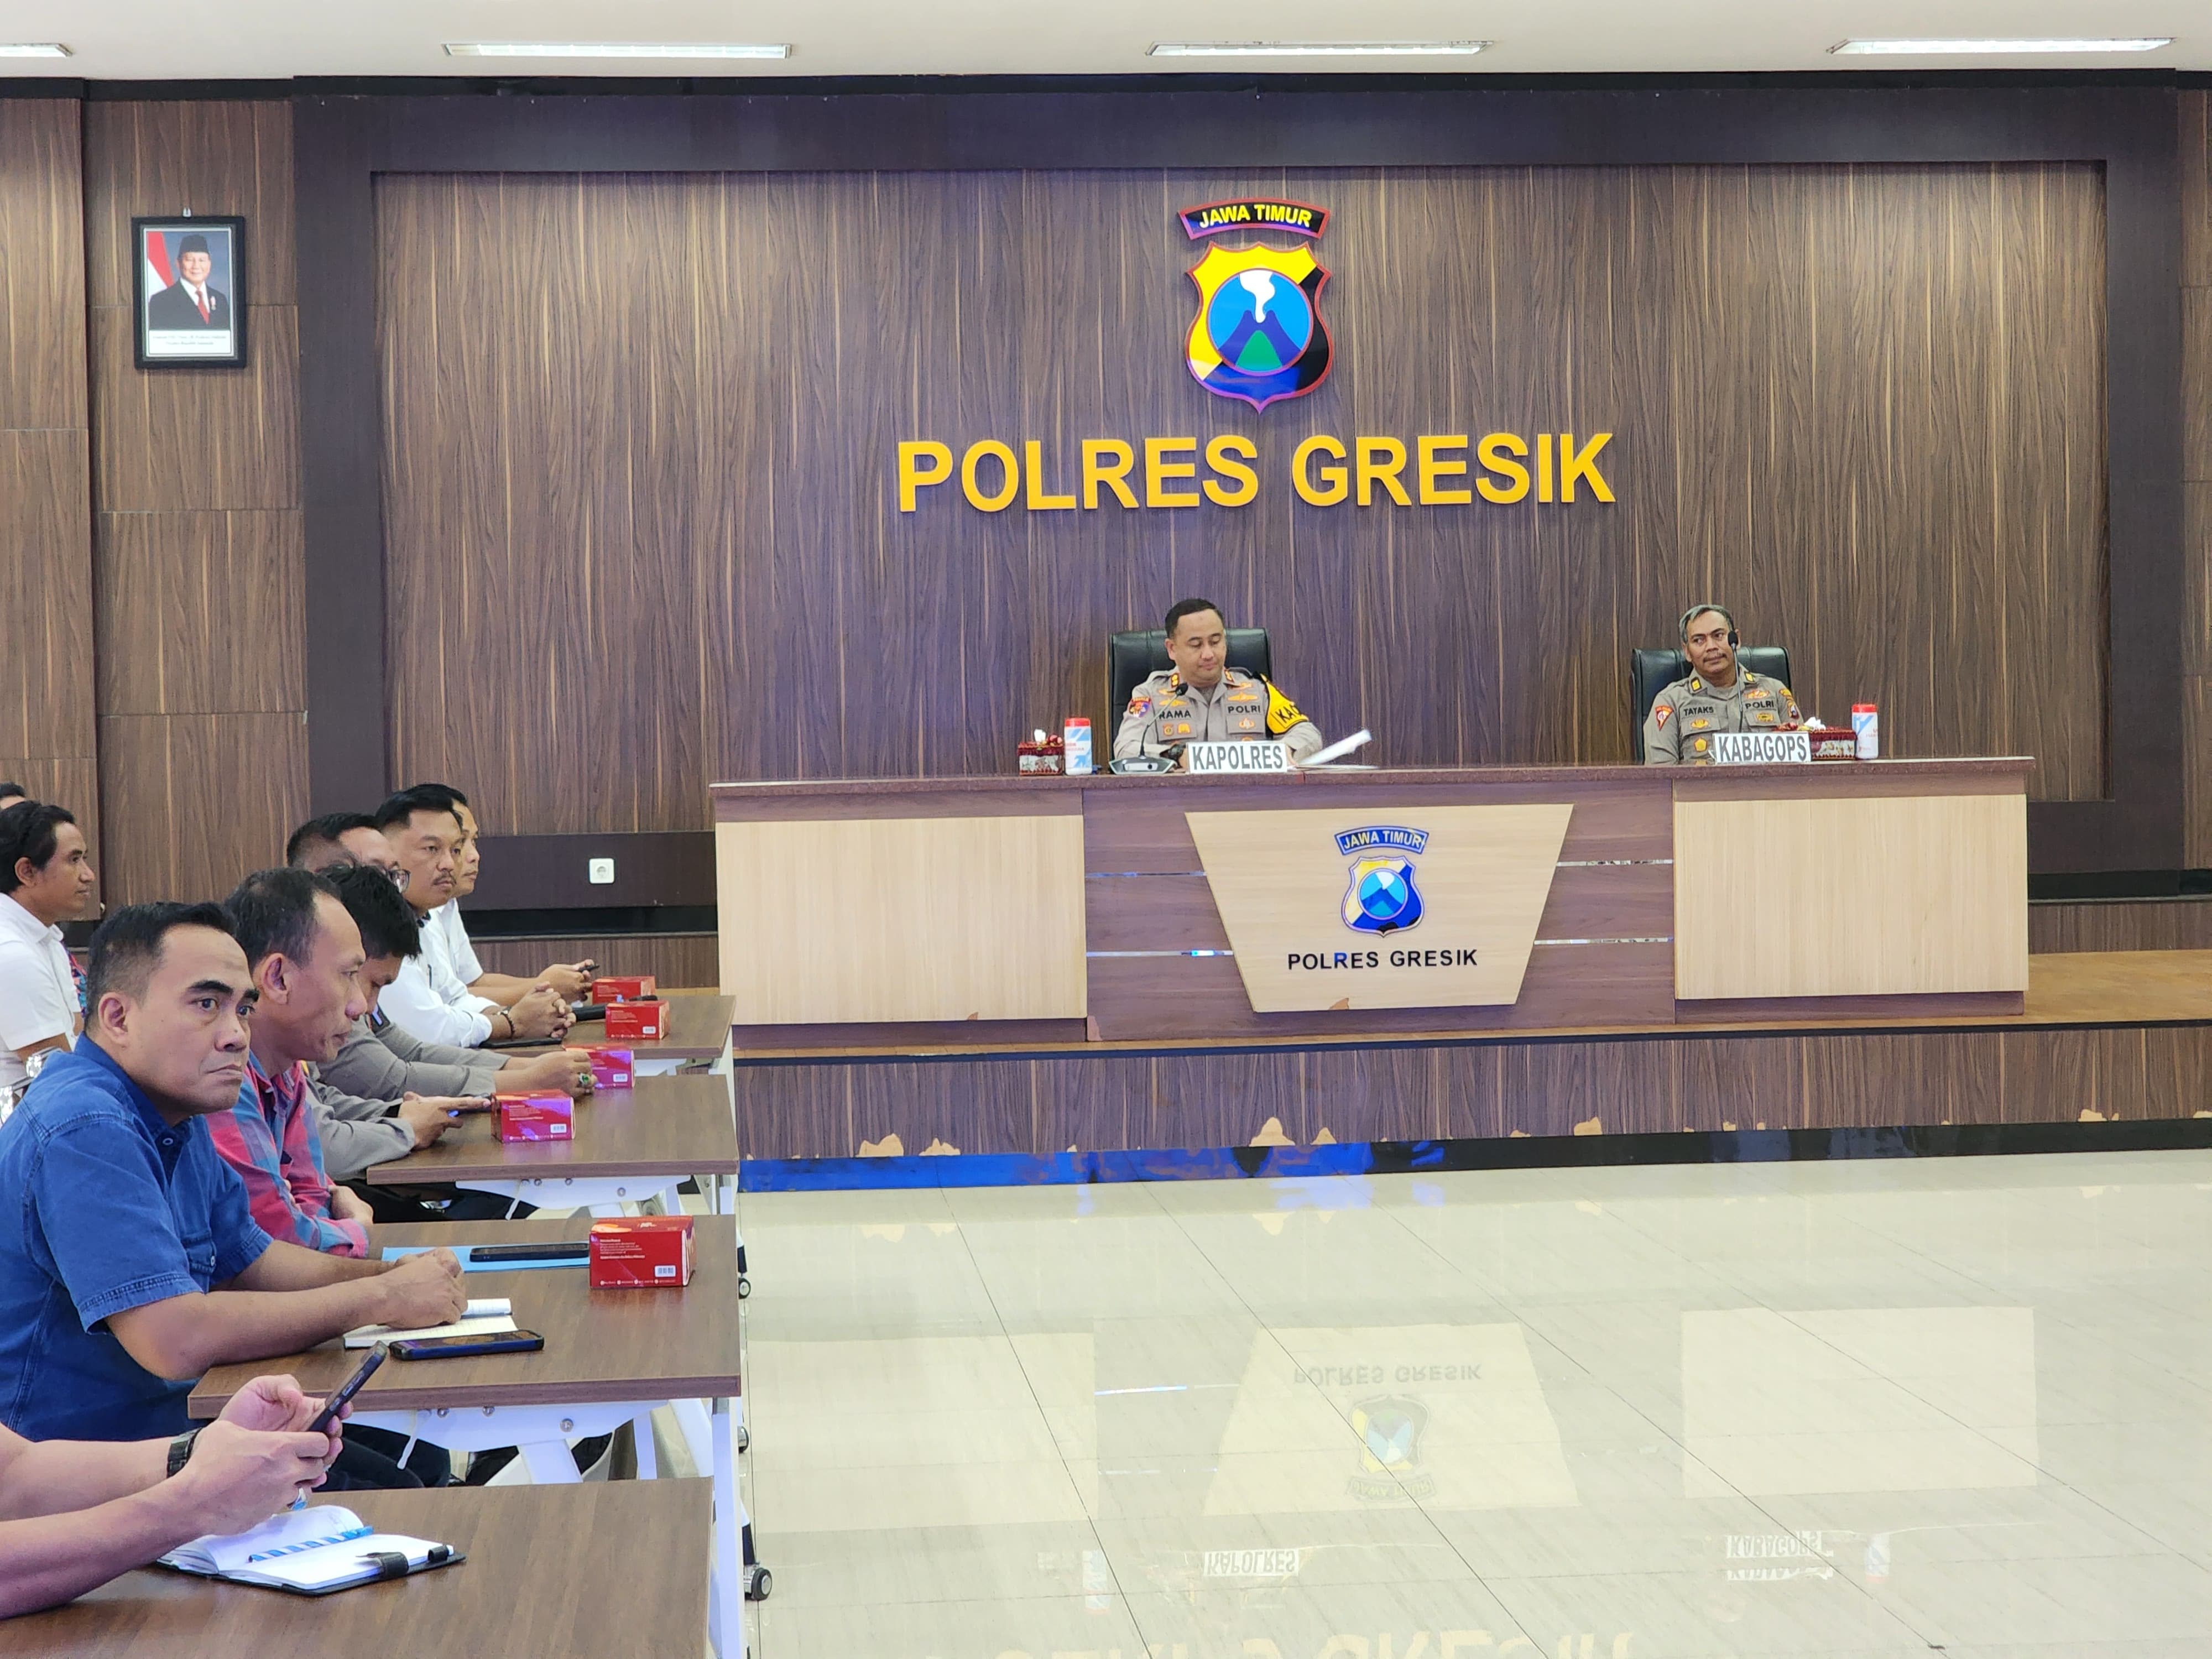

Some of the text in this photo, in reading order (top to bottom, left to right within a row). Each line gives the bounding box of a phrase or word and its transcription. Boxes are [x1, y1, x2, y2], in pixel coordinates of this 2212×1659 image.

[1199, 204, 1312, 229] JAWA TIMUR
[898, 433, 1616, 513] POLRES GRESIK
[1159, 709, 1192, 719] RAMA
[1228, 705, 1261, 714] POLRI
[1745, 700, 1774, 709] POLRI
[1192, 745, 1283, 770] KAPOLRES
[1718, 735, 1807, 762] KABAGOPS
[1344, 829, 1423, 850] JAWA TIMUR
[1288, 948, 1478, 970] POLRES GRESIK
